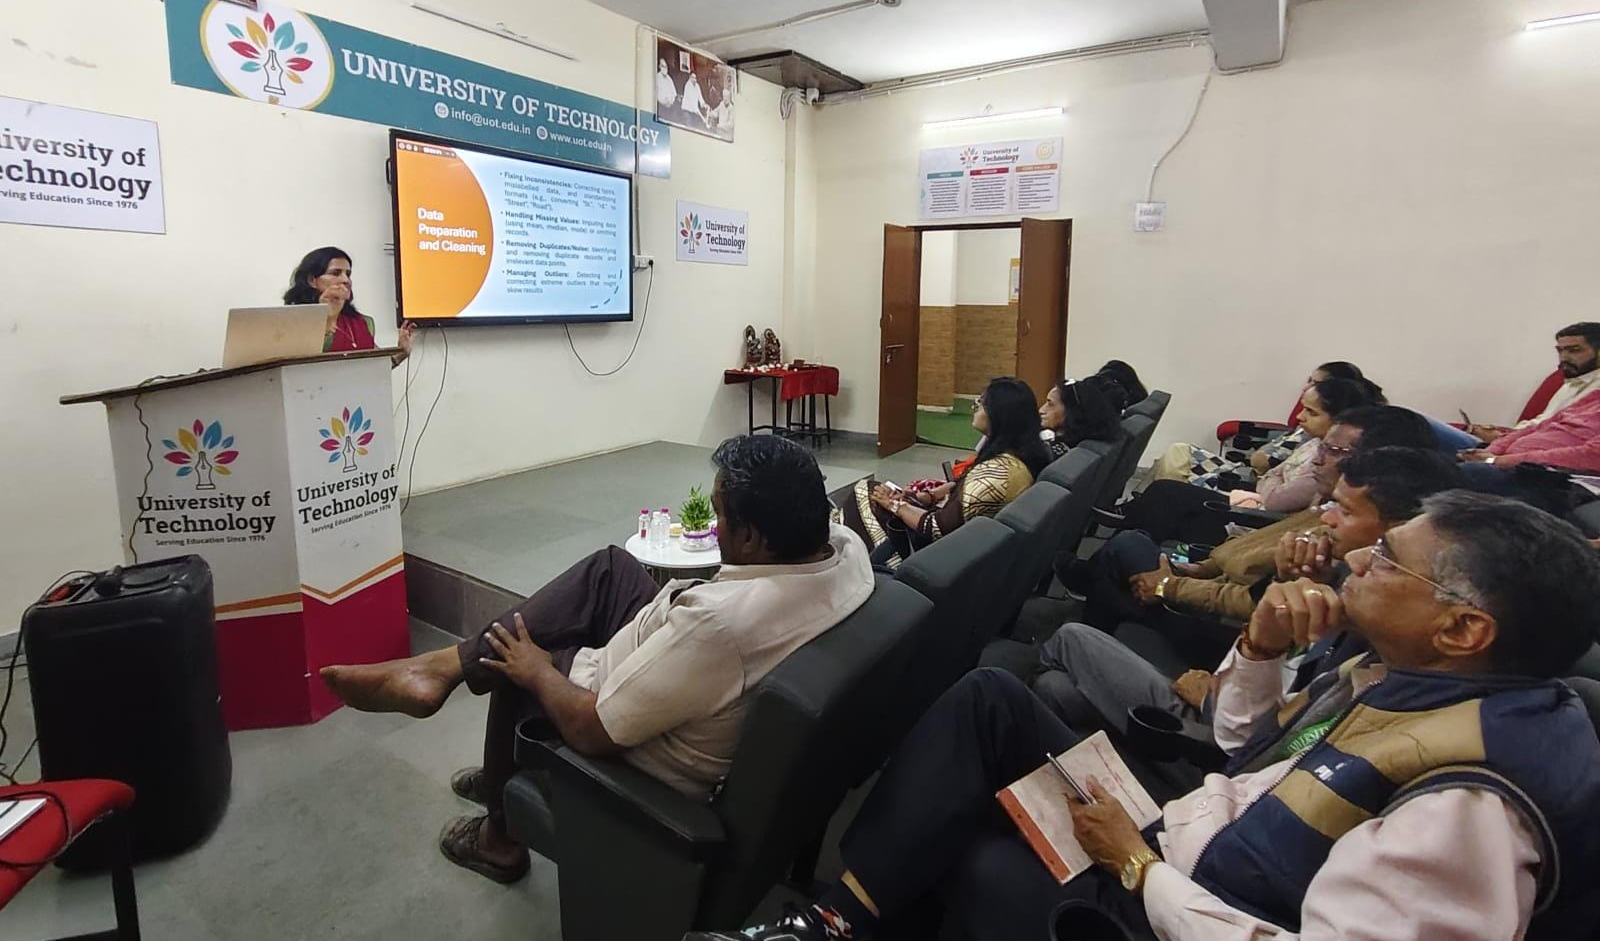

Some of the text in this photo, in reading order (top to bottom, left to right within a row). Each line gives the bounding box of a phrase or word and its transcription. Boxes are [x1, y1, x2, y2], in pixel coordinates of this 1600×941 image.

[341, 48, 660, 147] UNIVERSITY OF TECHNOLOGY
[451, 107, 612, 152] info@uot.edu.in www.uot.edu.in
[0, 127, 146, 167] iversity of
[0, 158, 152, 200] chnology
[504, 171, 523, 181] Fixing
[30, 192, 84, 205] Education
[86, 197, 113, 207] Since
[115, 200, 138, 209] 1976
[504, 189, 528, 199] formats
[417, 207, 444, 221] Data
[505, 210, 533, 220] Handling
[535, 213, 558, 223] Missing
[418, 223, 478, 238] Preparation
[705, 220, 738, 235] University
[419, 240, 486, 255] and Cleaning
[506, 240, 536, 250] Removing
[705, 233, 746, 250] Technology
[523, 250, 550, 258] removing
[507, 269, 536, 277] Managing
[297, 464, 395, 503] University of
[136, 490, 271, 511] University of
[298, 485, 399, 525] Technology
[138, 513, 276, 534] Technology
[335, 514, 363, 527] Education
[226, 535, 246, 543] Since
